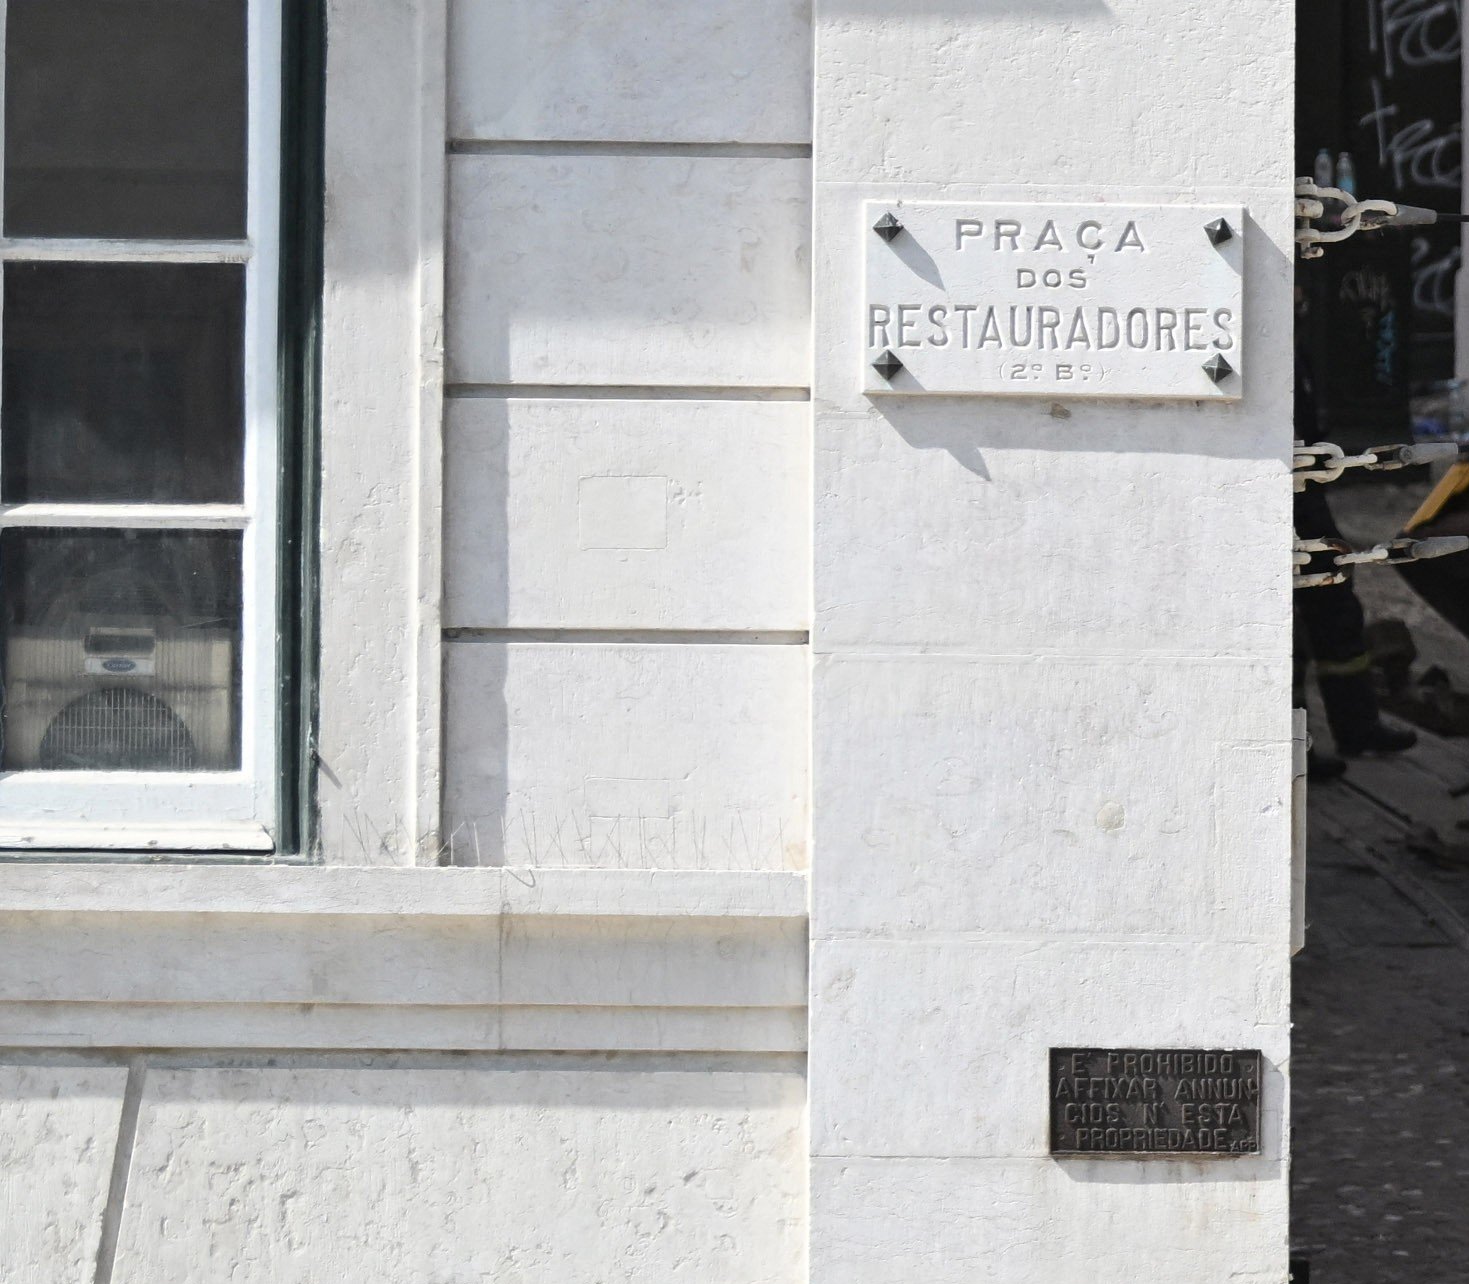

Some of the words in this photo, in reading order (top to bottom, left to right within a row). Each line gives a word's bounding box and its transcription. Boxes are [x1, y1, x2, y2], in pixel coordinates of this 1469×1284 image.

[955, 218, 1146, 265] PRAÇA
[1015, 267, 1088, 290] DOS
[868, 303, 1236, 352] RESTAURADORES
[1107, 1052, 1234, 1075] PROHIBIDO
[1055, 1077, 1157, 1100] AFFIXAR
[1064, 1102, 1122, 1124] CIOS
[1181, 1102, 1243, 1125] ESTA
[1075, 1127, 1228, 1150] PROPRIEDADE
